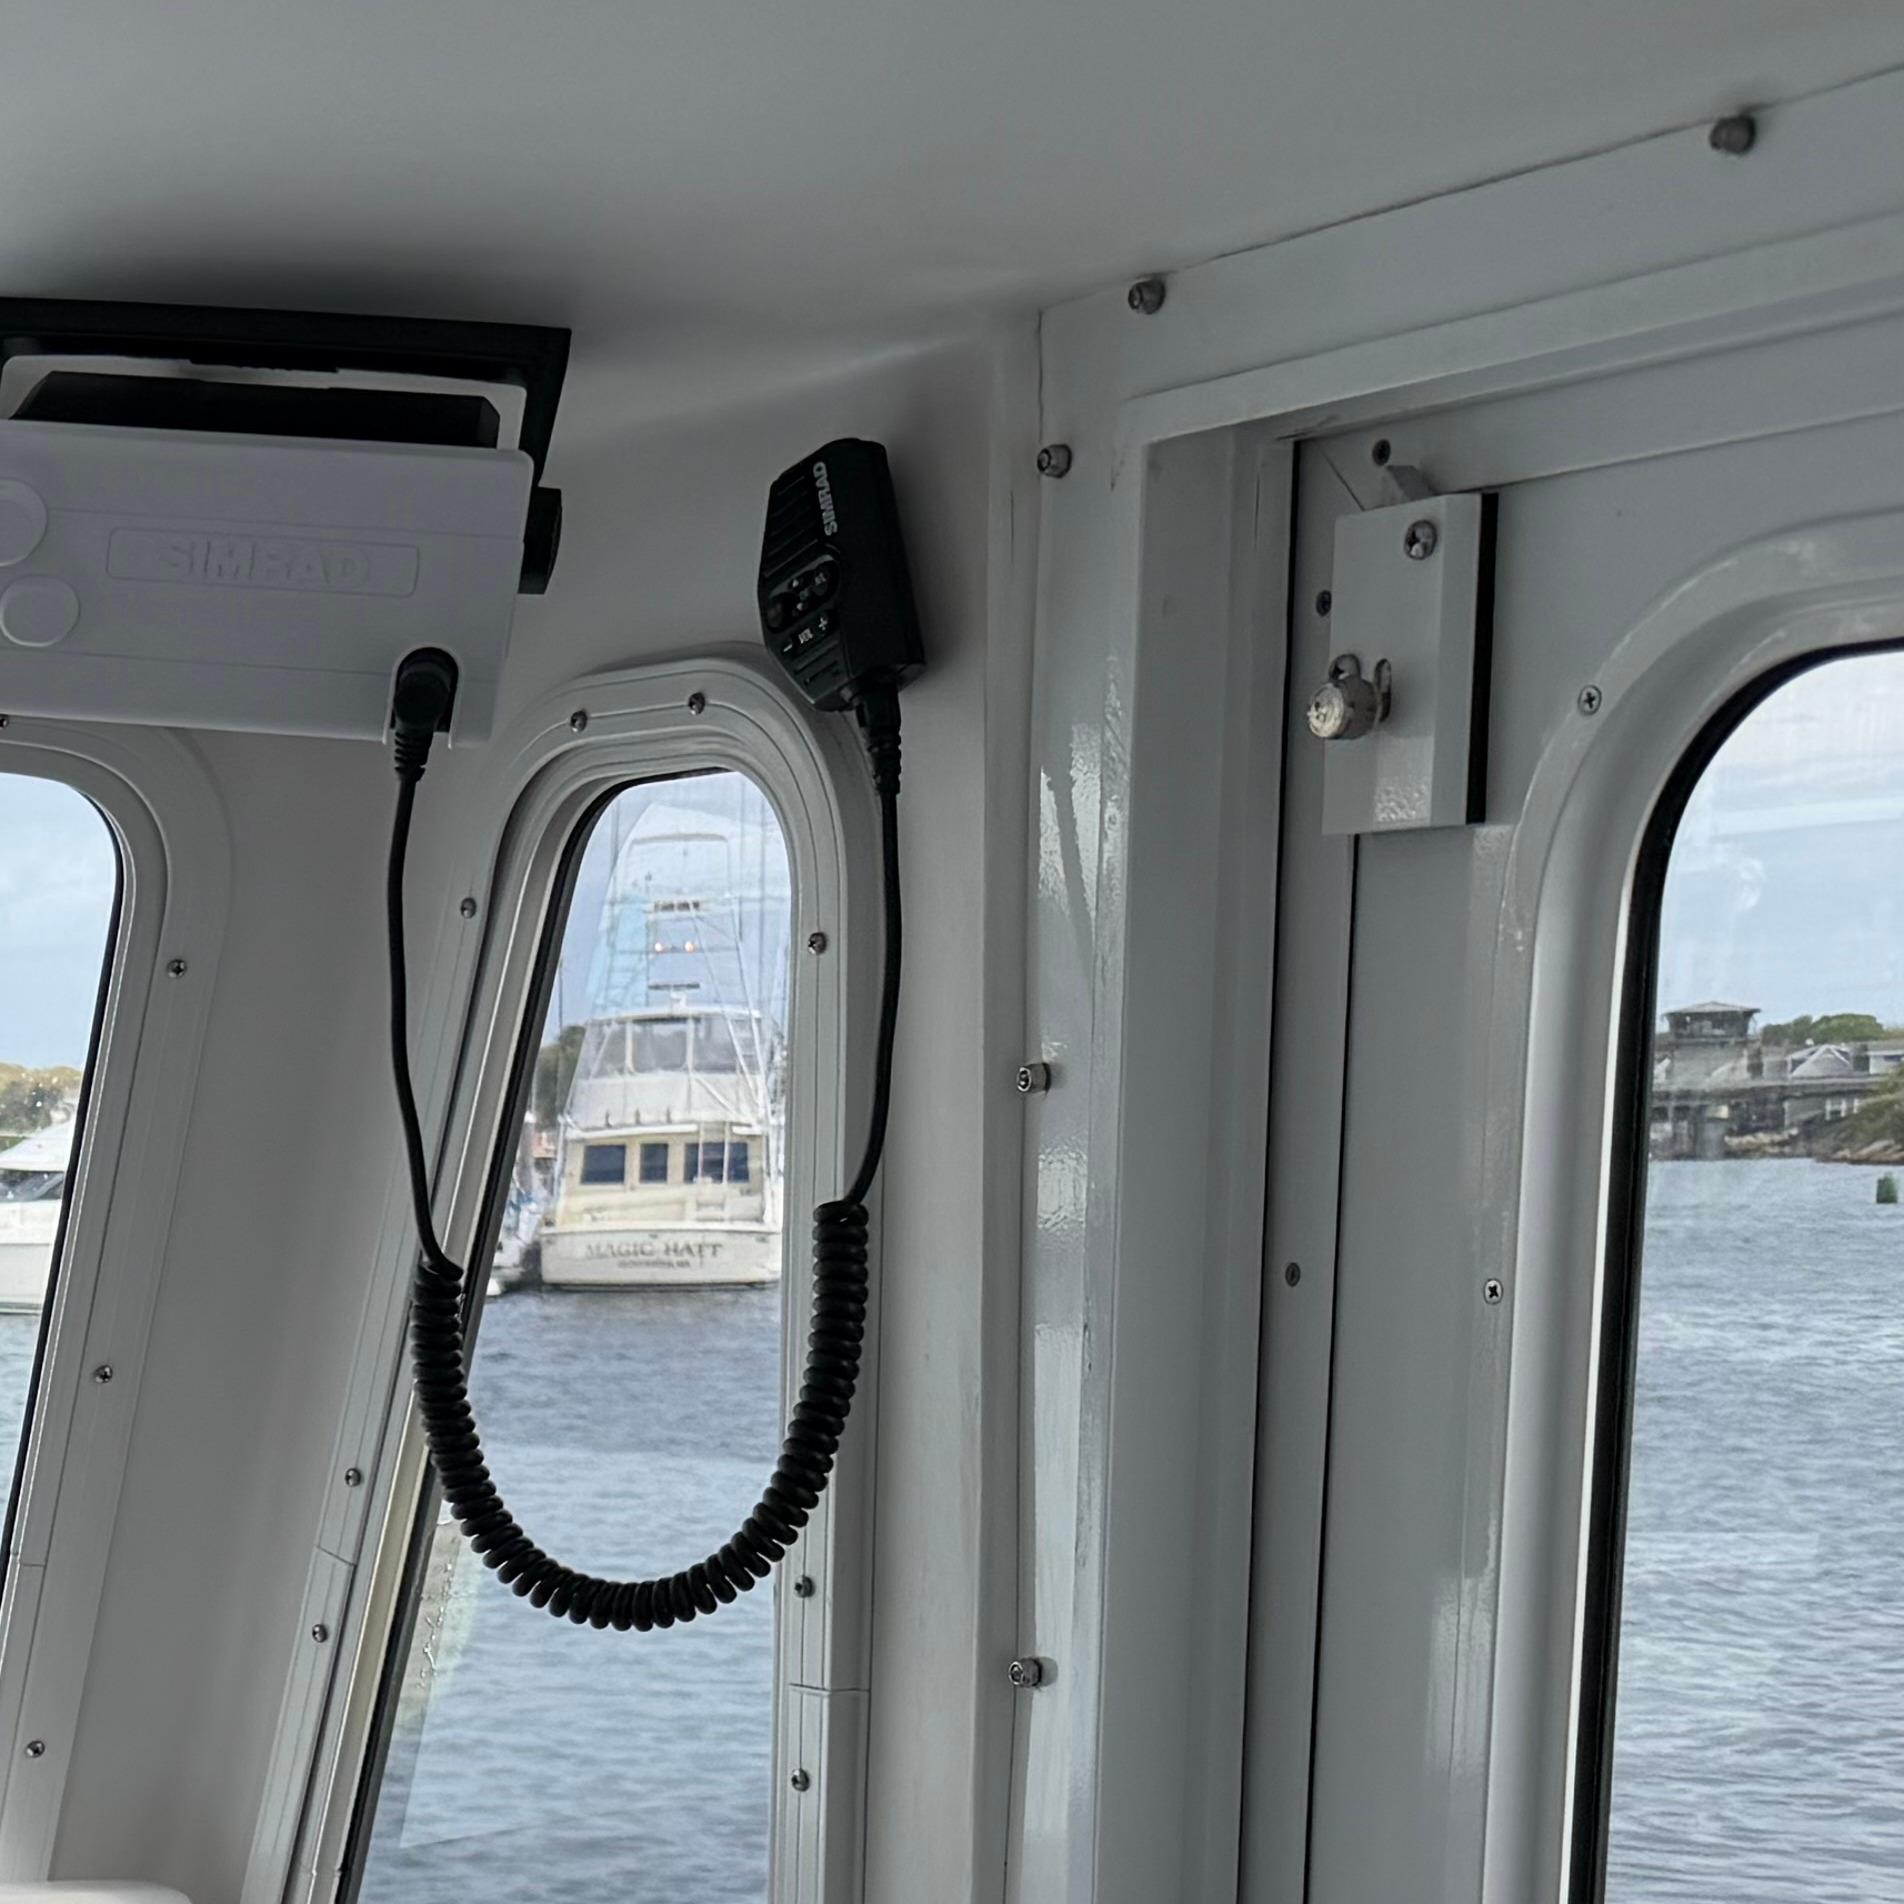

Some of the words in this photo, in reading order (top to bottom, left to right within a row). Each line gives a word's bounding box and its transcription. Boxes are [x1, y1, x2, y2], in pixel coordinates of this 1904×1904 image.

[812, 461, 839, 537] SIMRAD
[154, 539, 376, 583] SIMRAD
[665, 1241, 722, 1258] HATT
